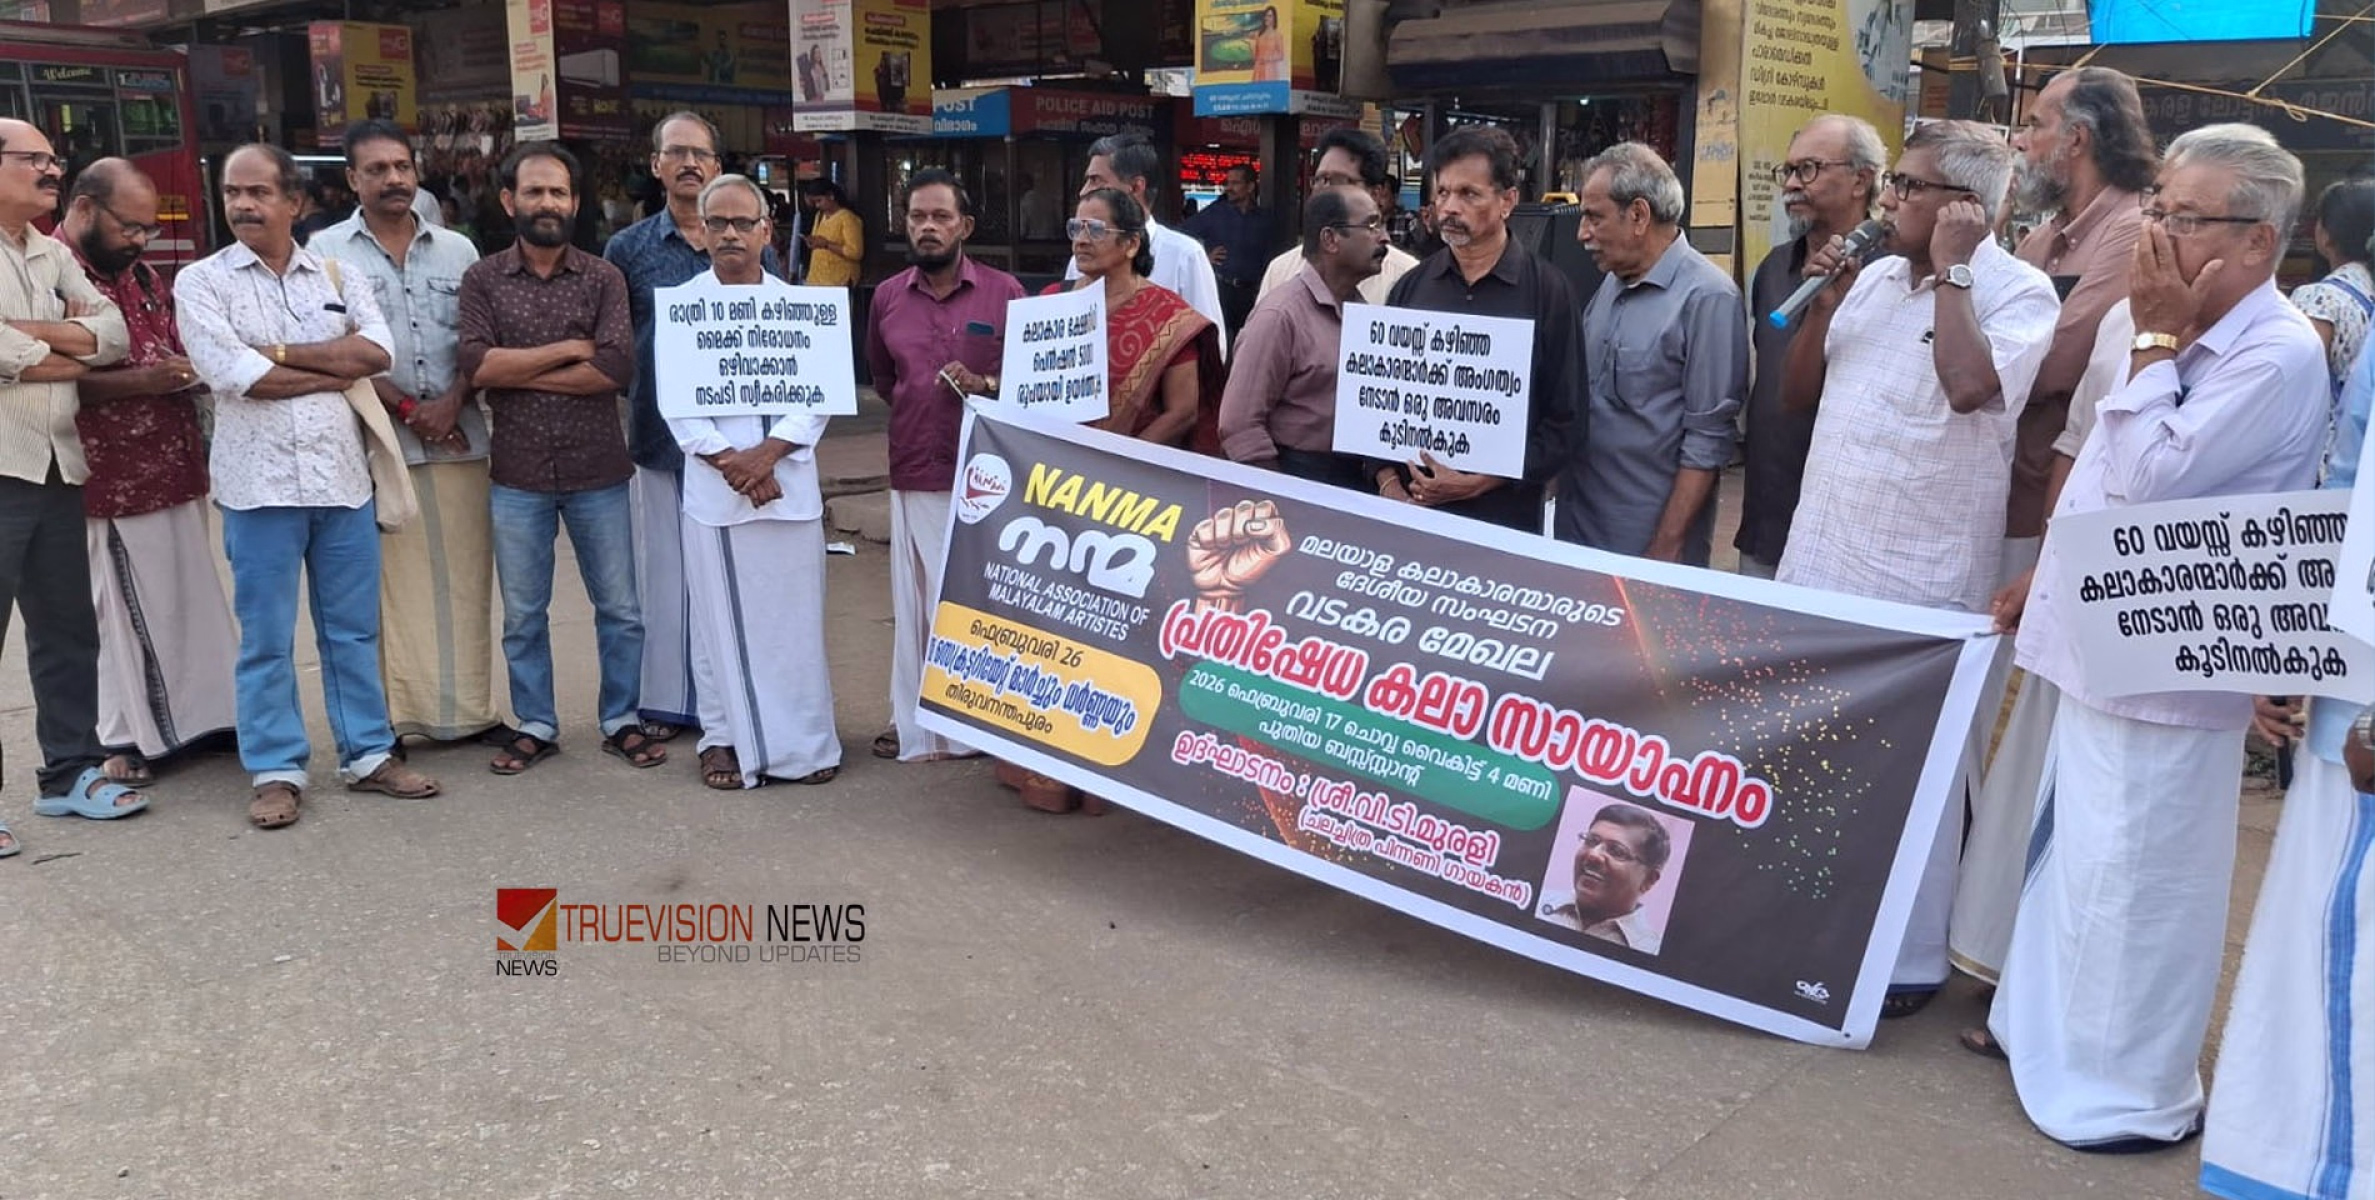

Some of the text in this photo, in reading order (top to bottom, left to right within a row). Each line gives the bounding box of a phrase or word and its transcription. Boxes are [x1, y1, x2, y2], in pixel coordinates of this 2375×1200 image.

[1036, 97, 1154, 119] POLICE AID POST
[669, 296, 838, 326] രാത്രി 10 മണി കഴിഞ്ഞുള്ള
[1022, 318, 1066, 343] കലാകാര
[697, 325, 811, 349] മൈക്ക് നിരോധനം
[1033, 343, 1076, 373] പെൻഷൻ
[1370, 320, 1491, 357] 60 വയസ്സ് കഴിഞ്ഞ
[719, 352, 798, 377] ഒഴിവാക്കാൻ
[1454, 363, 1521, 398] അംഗത്വം
[696, 379, 825, 407] നടപടി സ്വീകരിക്കുക
[1358, 385, 1500, 425] നേടാൻ ഒരു അവസരം
[1023, 462, 1182, 542] NANMA
[999, 515, 1157, 599] നന്മ
[2113, 507, 2348, 557] 60 വയസ്സ് കഴിഞ്ഞ
[983, 562, 1150, 626] NATIONAL ASSOCIATION OF
[1299, 535, 1625, 626] മലയാള കലാകാരന്മാരുടെ
[1336, 571, 1558, 640] ദേശീയ സംഘടന
[988, 583, 1129, 641] MALAYALAM ARTISTES
[1286, 590, 1554, 681] വടകര മേഖല
[2117, 600, 2203, 637] നേടാൻ
[2213, 604, 2263, 640] ഒരു
[970, 618, 1060, 660] ഫെബ്രുവരി
[1060, 649, 1084, 669] 26
[945, 683, 1054, 734] തിരുവനന്തപുരം
[1160, 599, 1773, 829] പ്രതിഷേധ കലാ സായാഹ്നം
[1259, 718, 1321, 749] പുതിയ
[1188, 669, 1552, 801] 2026 ഫെബ്രുവരി 17 ചൊവ്വ വൈകിട്ട് 4 മണി
[1172, 730, 1296, 796] ഉദ്ഘാടനം
[1374, 838, 1441, 877] പിന്നണി
[1442, 854, 1532, 909] ഗായകൻ)
